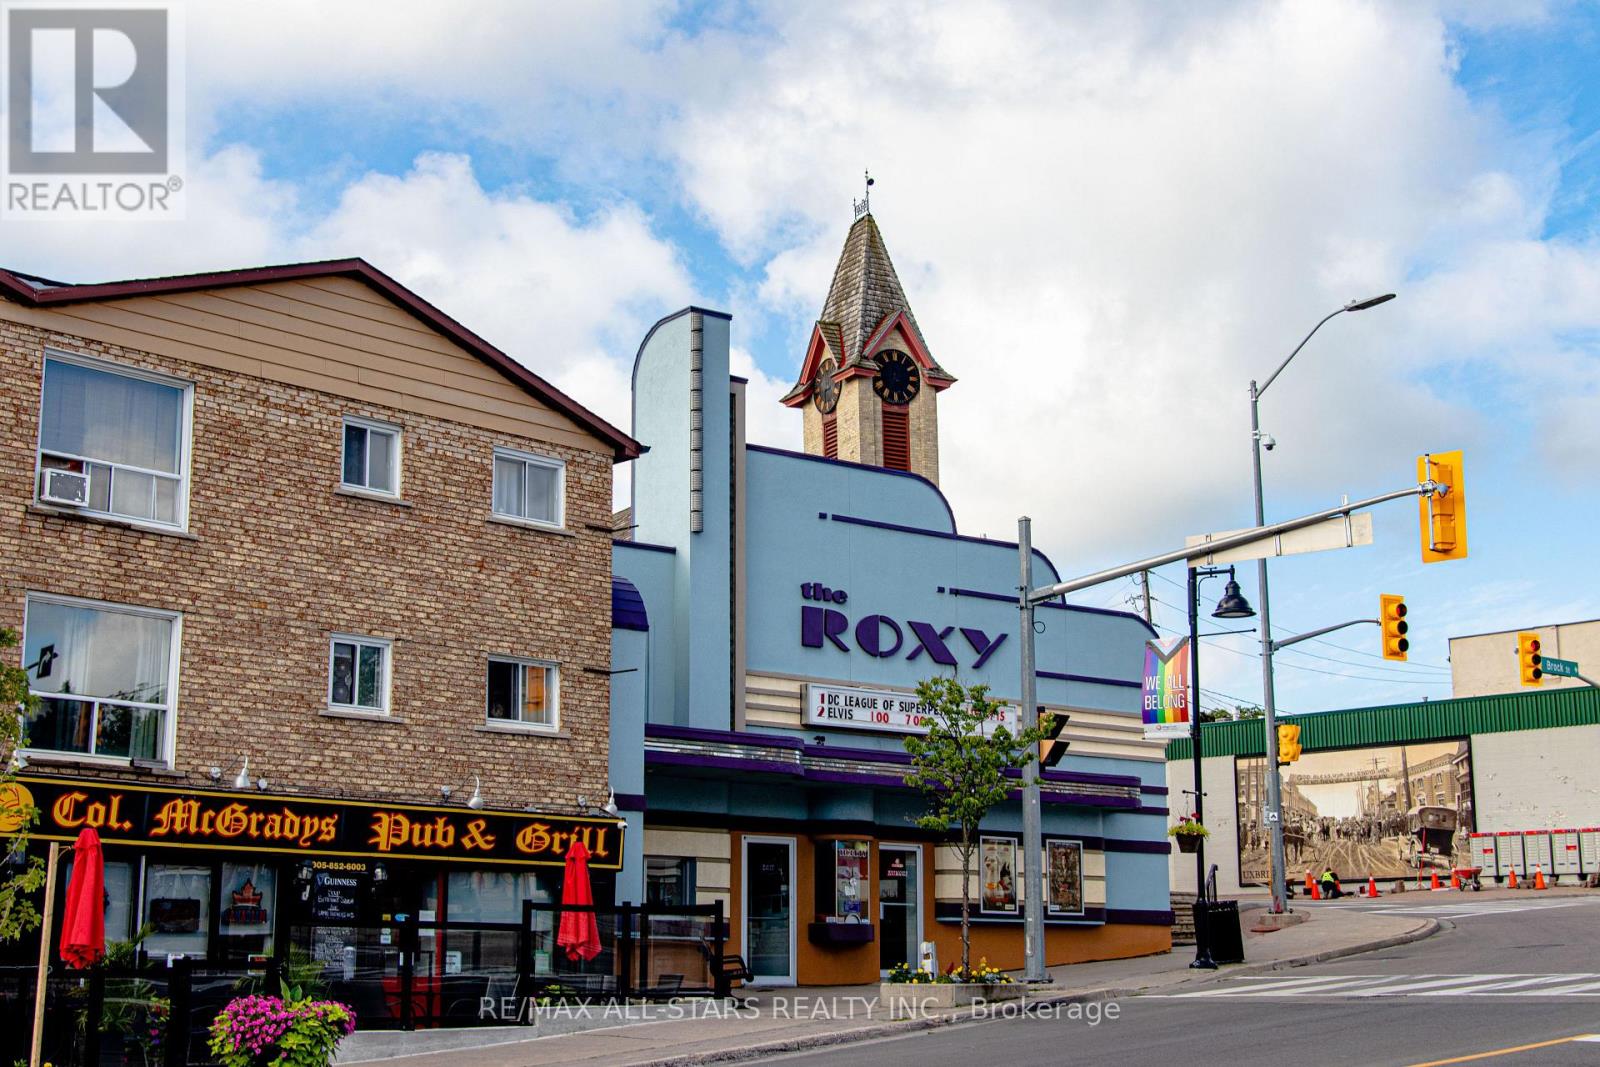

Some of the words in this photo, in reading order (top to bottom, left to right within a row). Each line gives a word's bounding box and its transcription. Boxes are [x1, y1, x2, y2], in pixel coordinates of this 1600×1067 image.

[801, 582, 849, 604] the
[801, 605, 1009, 669] ROXY
[1546, 660, 1564, 673] Brock
[1145, 675, 1161, 691] WE
[1167, 673, 1185, 690] ALL
[827, 694, 840, 706] DC
[844, 695, 878, 710] LEAGUE
[883, 699, 894, 711] OF
[1144, 693, 1185, 711] BELONG
[827, 707, 853, 720] ELVIS
[53, 791, 132, 830] Col.
[150, 797, 338, 847] McGradys
[368, 812, 455, 851] Pub
[460, 817, 496, 850] &
